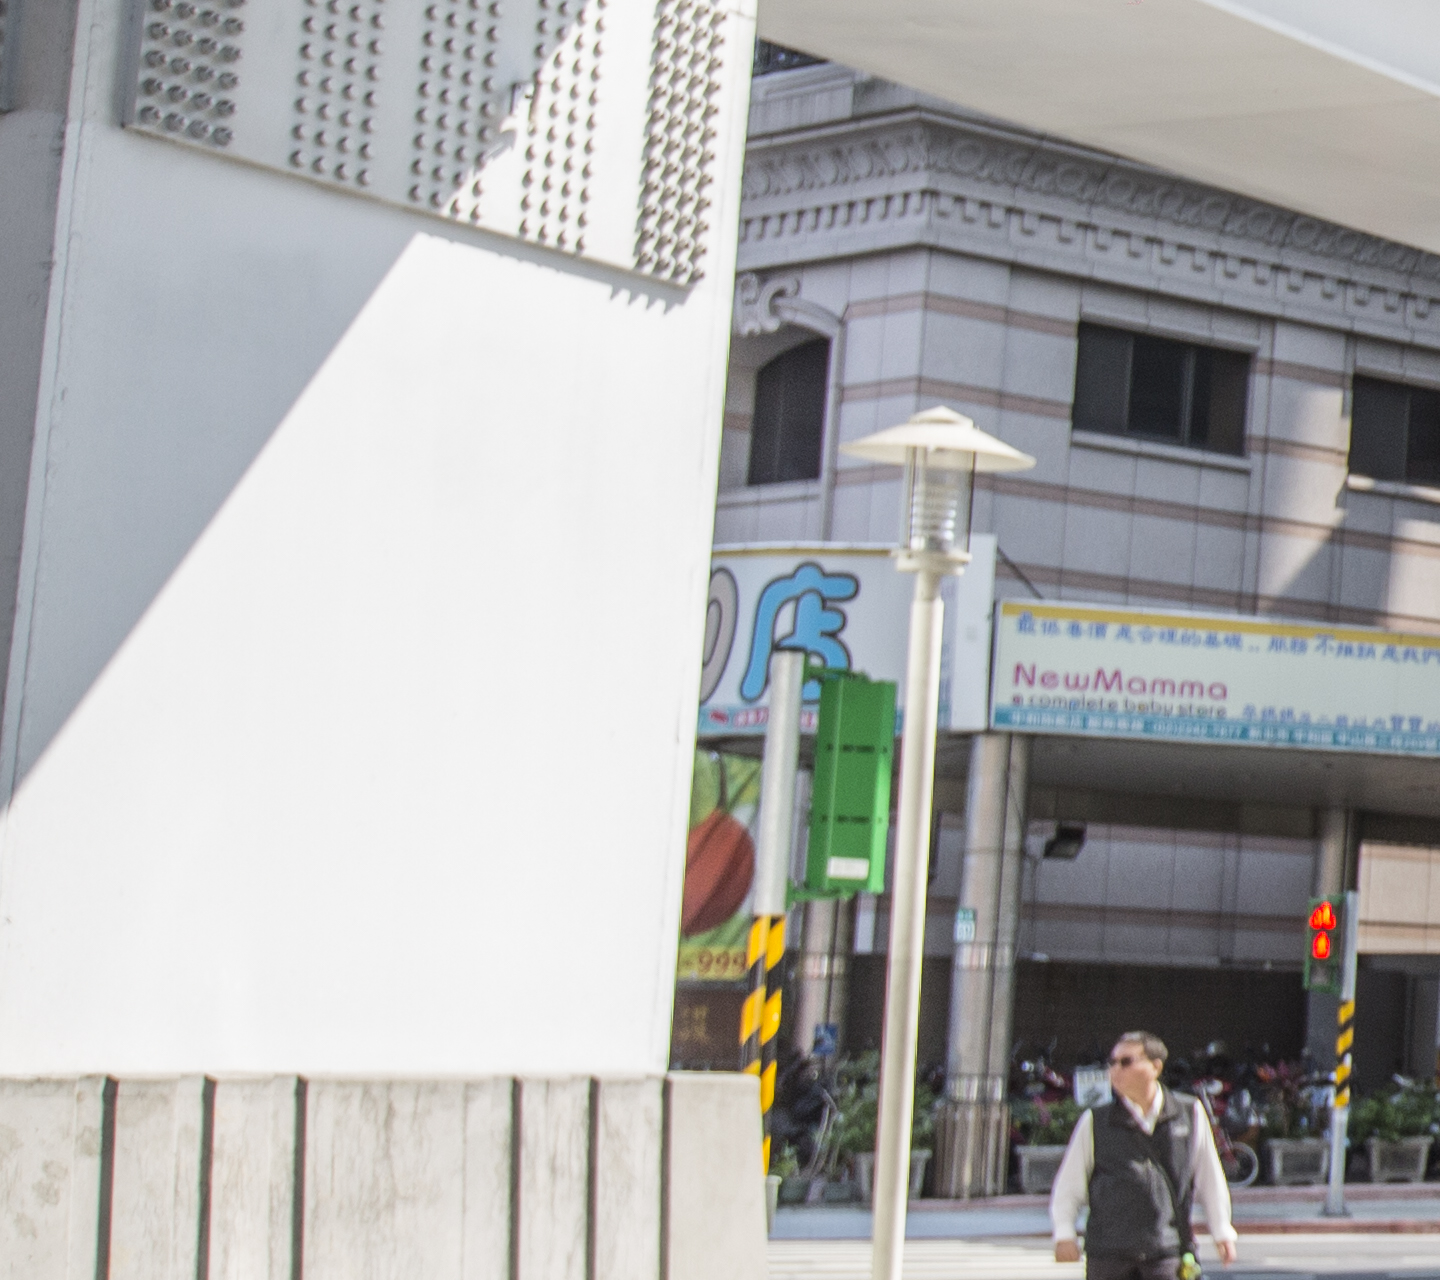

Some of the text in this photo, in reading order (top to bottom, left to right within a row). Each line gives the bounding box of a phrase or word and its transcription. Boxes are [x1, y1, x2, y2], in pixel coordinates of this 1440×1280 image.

[1013, 661, 1229, 702] NewMamma
[1028, 693, 1119, 713] complete
[1177, 701, 1228, 719] store
